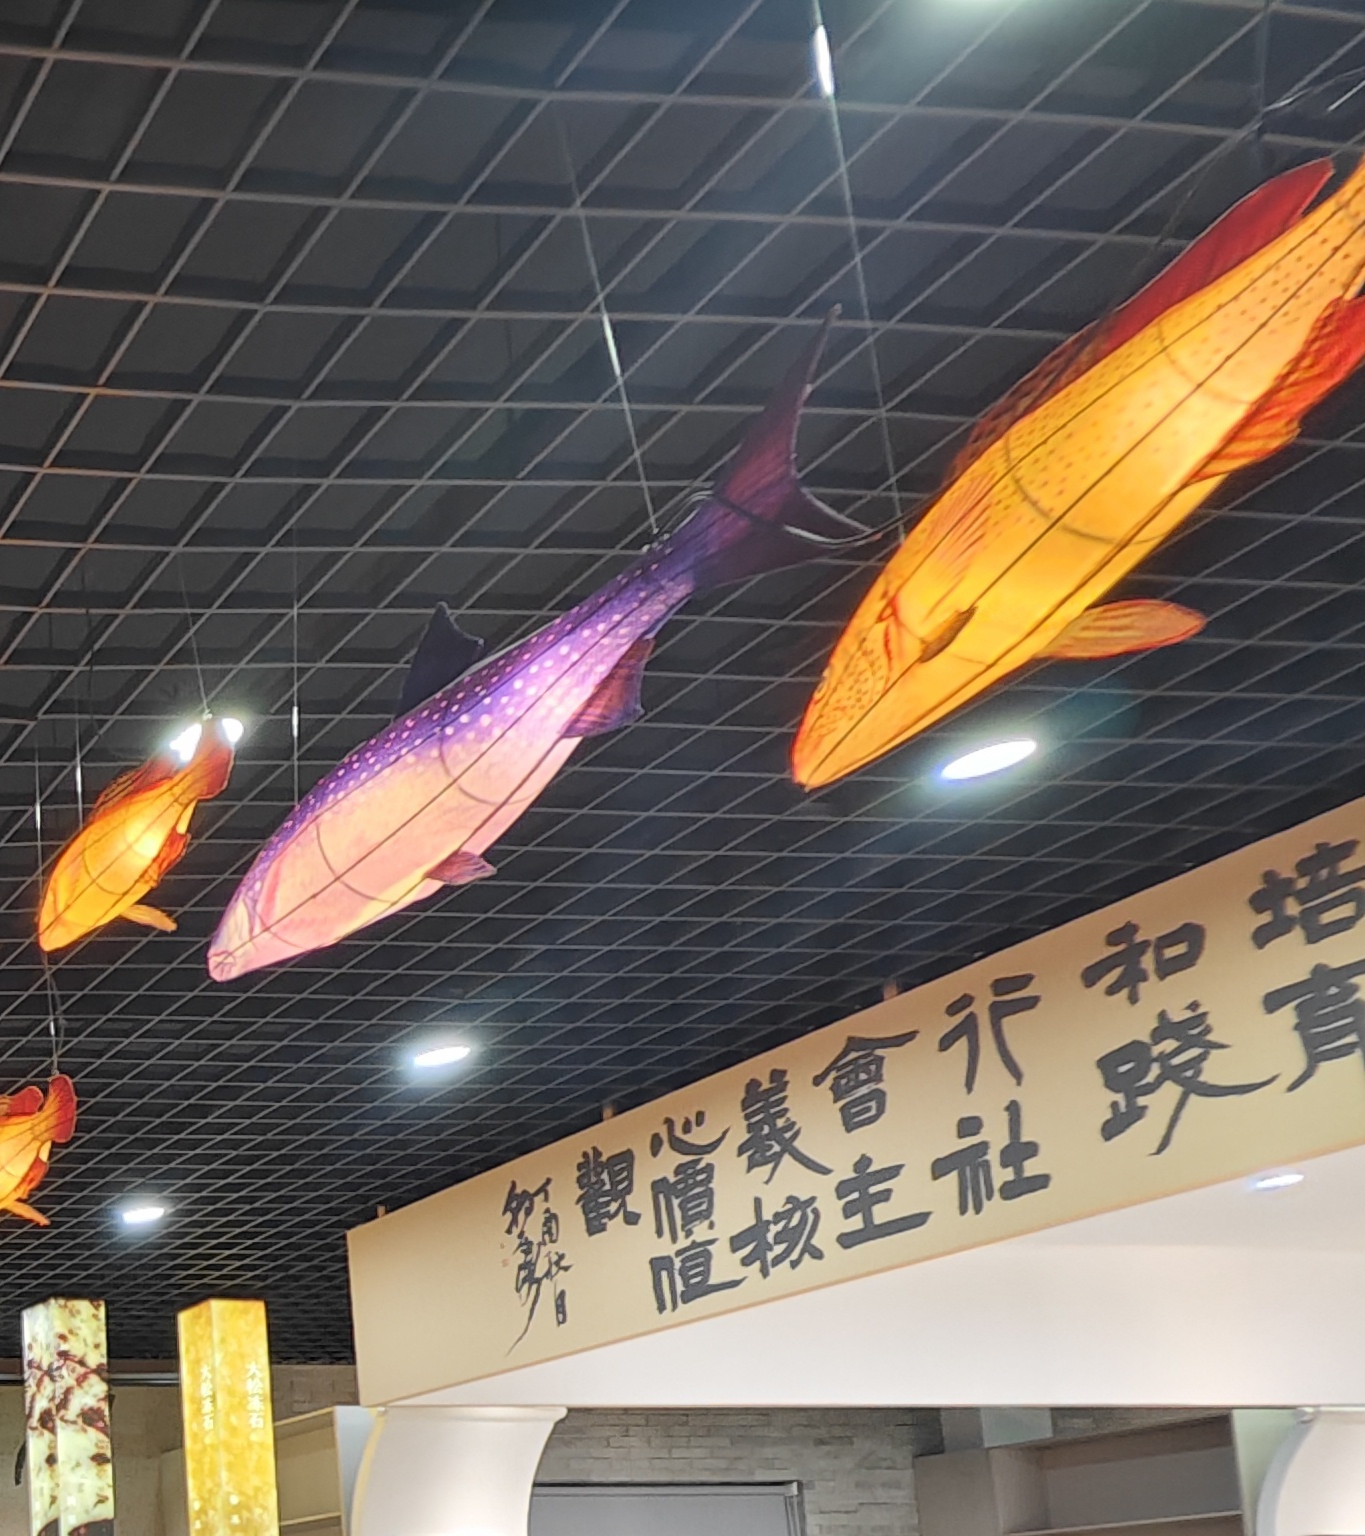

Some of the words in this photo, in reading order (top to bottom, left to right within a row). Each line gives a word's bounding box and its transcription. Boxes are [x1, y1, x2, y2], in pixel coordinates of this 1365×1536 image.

[1080, 920, 1281, 1157] 和踐
[1248, 839, 1365, 1093] 培育
[576, 1146, 642, 1237] 觀
[729, 1068, 834, 1280] 義核
[811, 1030, 933, 1250] 會主
[931, 973, 1051, 1216] 行社
[649, 1110, 748, 1316] 心價值
